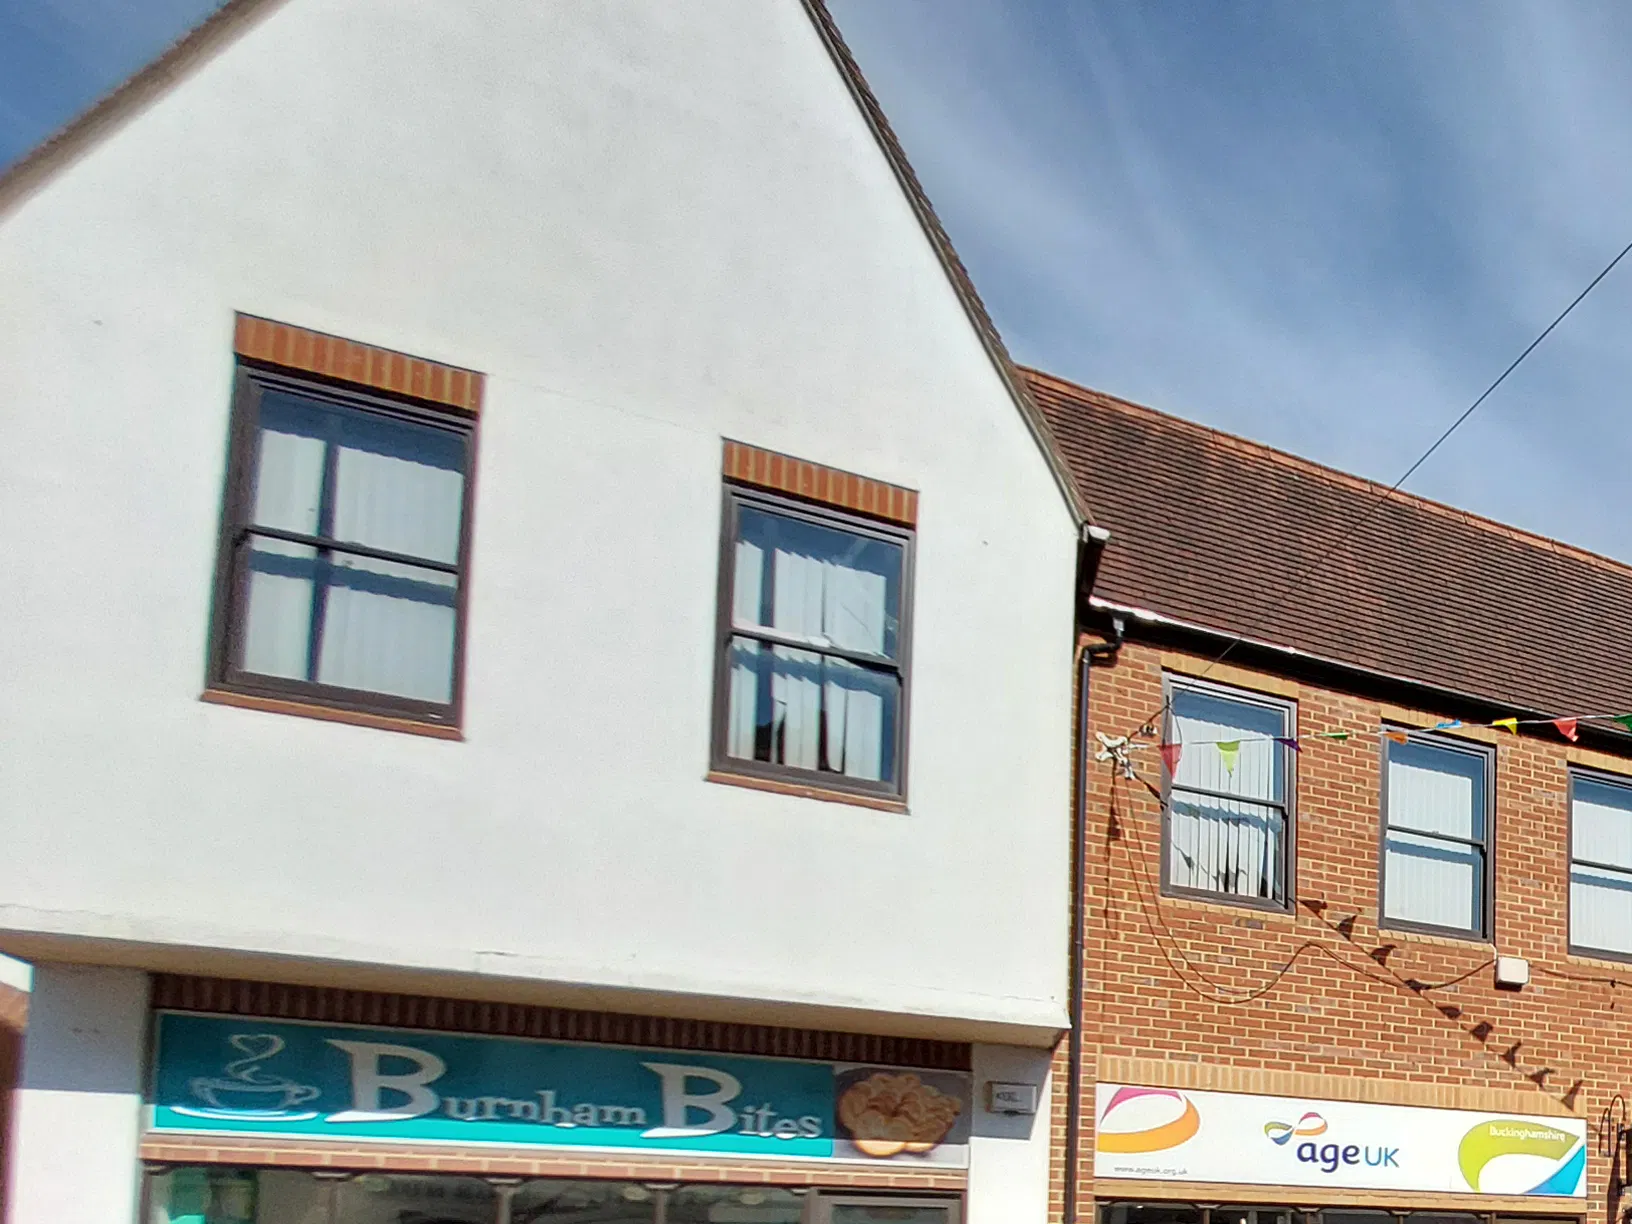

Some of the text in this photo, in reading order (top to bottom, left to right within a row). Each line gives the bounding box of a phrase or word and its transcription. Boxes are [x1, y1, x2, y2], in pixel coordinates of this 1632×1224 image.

[324, 1038, 823, 1139] Burnham Bites
[1489, 1124, 1566, 1143] Buckinghamshire
